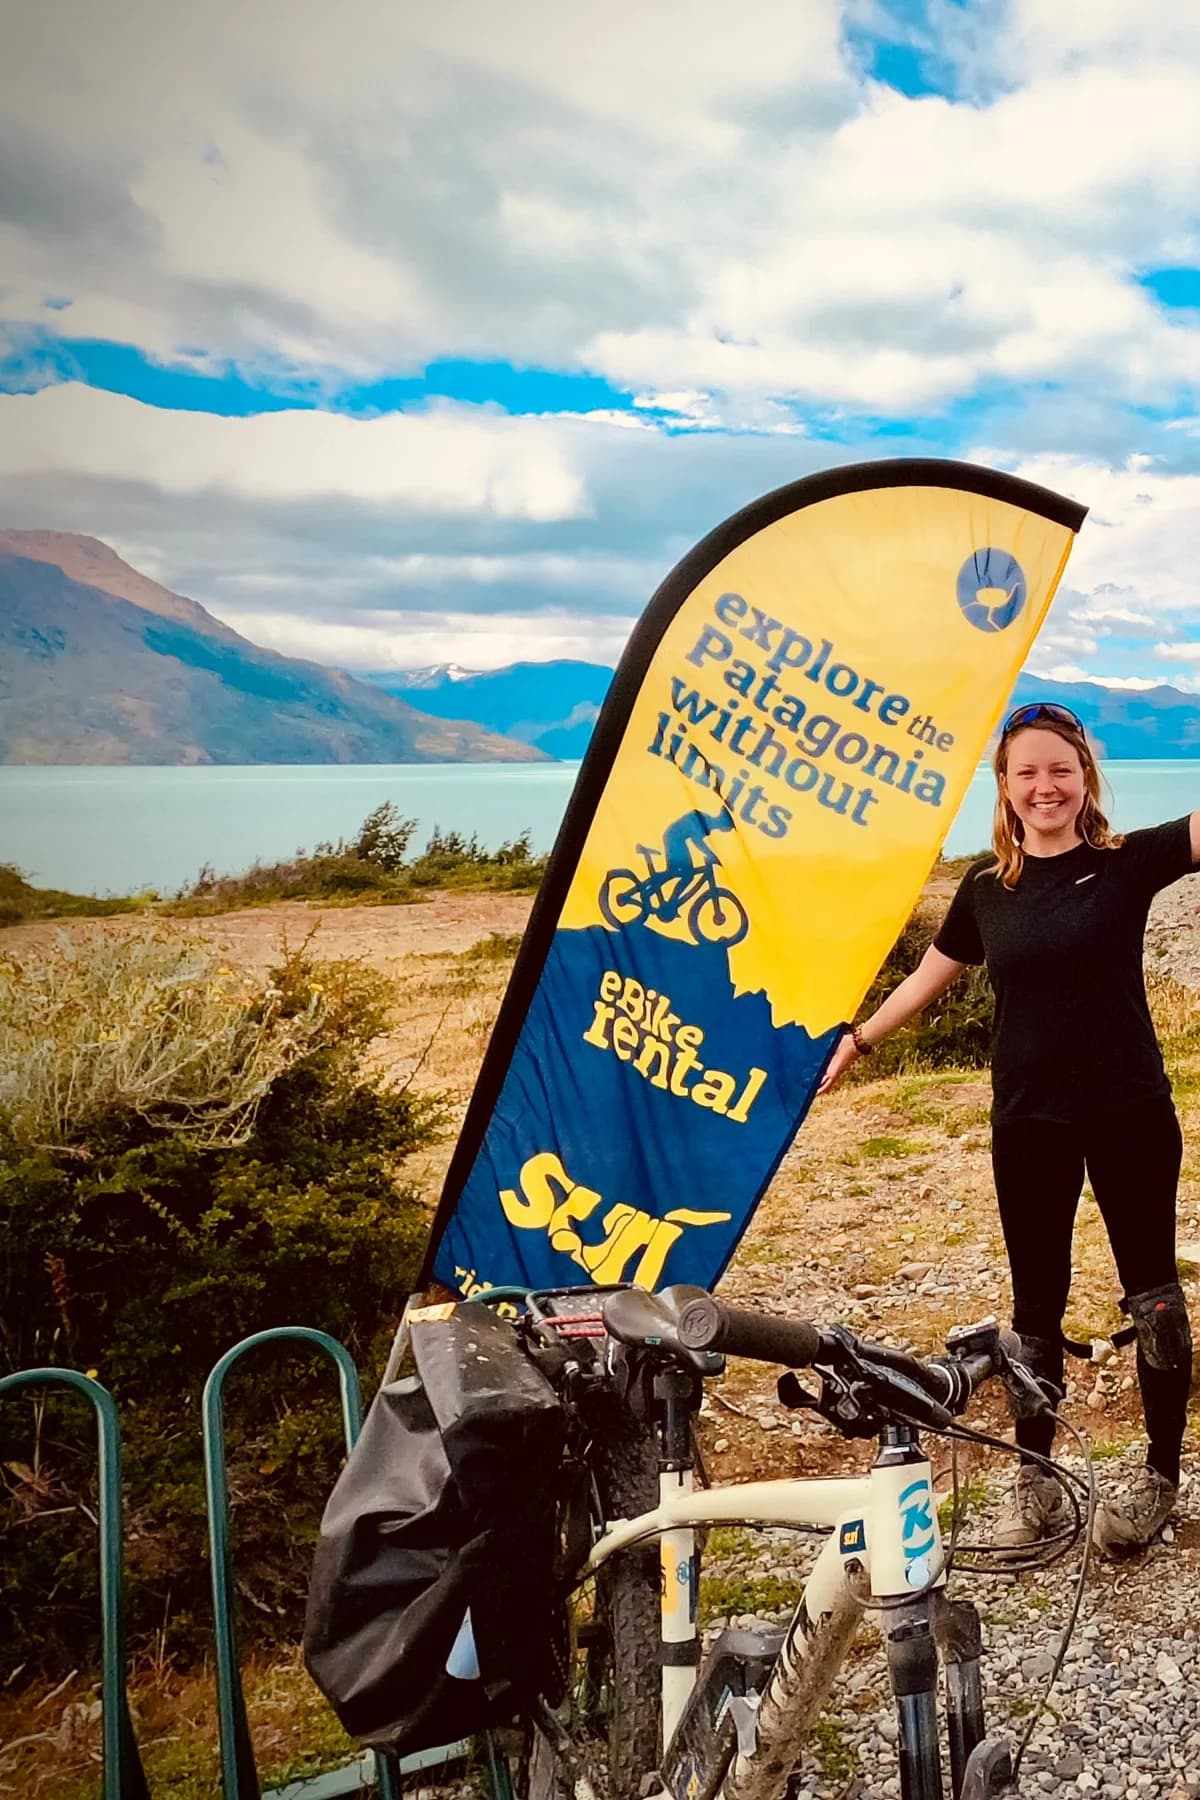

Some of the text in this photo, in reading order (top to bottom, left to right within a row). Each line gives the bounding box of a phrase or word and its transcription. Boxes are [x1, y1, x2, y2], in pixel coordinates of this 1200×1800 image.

[685, 624, 947, 807] Patagonia
[714, 592, 955, 753] explore the
[646, 711, 793, 839] limits
[671, 676, 879, 826] without
[583, 1002, 768, 1123] rental
[600, 971, 704, 1051] eBike
